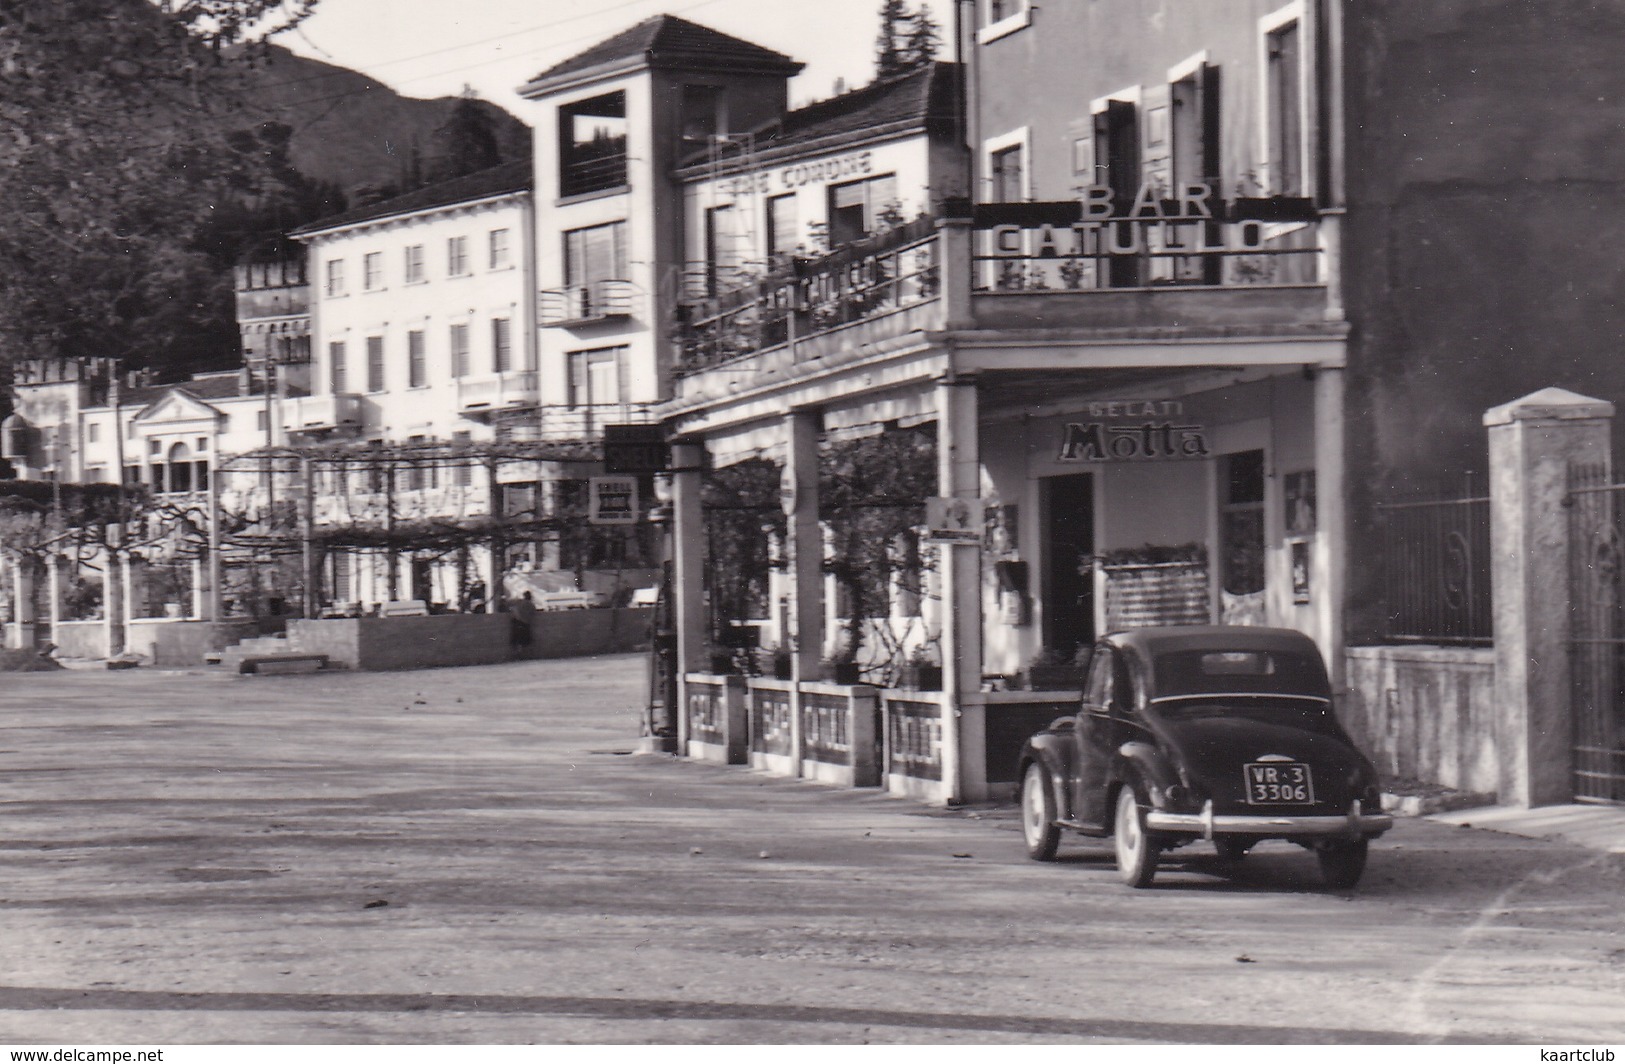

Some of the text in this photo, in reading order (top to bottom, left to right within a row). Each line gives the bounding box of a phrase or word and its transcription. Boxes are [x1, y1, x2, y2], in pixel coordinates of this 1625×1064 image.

[781, 151, 872, 189] CORONE
[1082, 181, 1212, 222] BAR
[992, 219, 1265, 257] CATULLO
[1088, 401, 1184, 417] GELATI
[1058, 421, 1210, 461] Motta
[1251, 767, 1304, 783] VR 3
[1255, 784, 1307, 801] 3306
